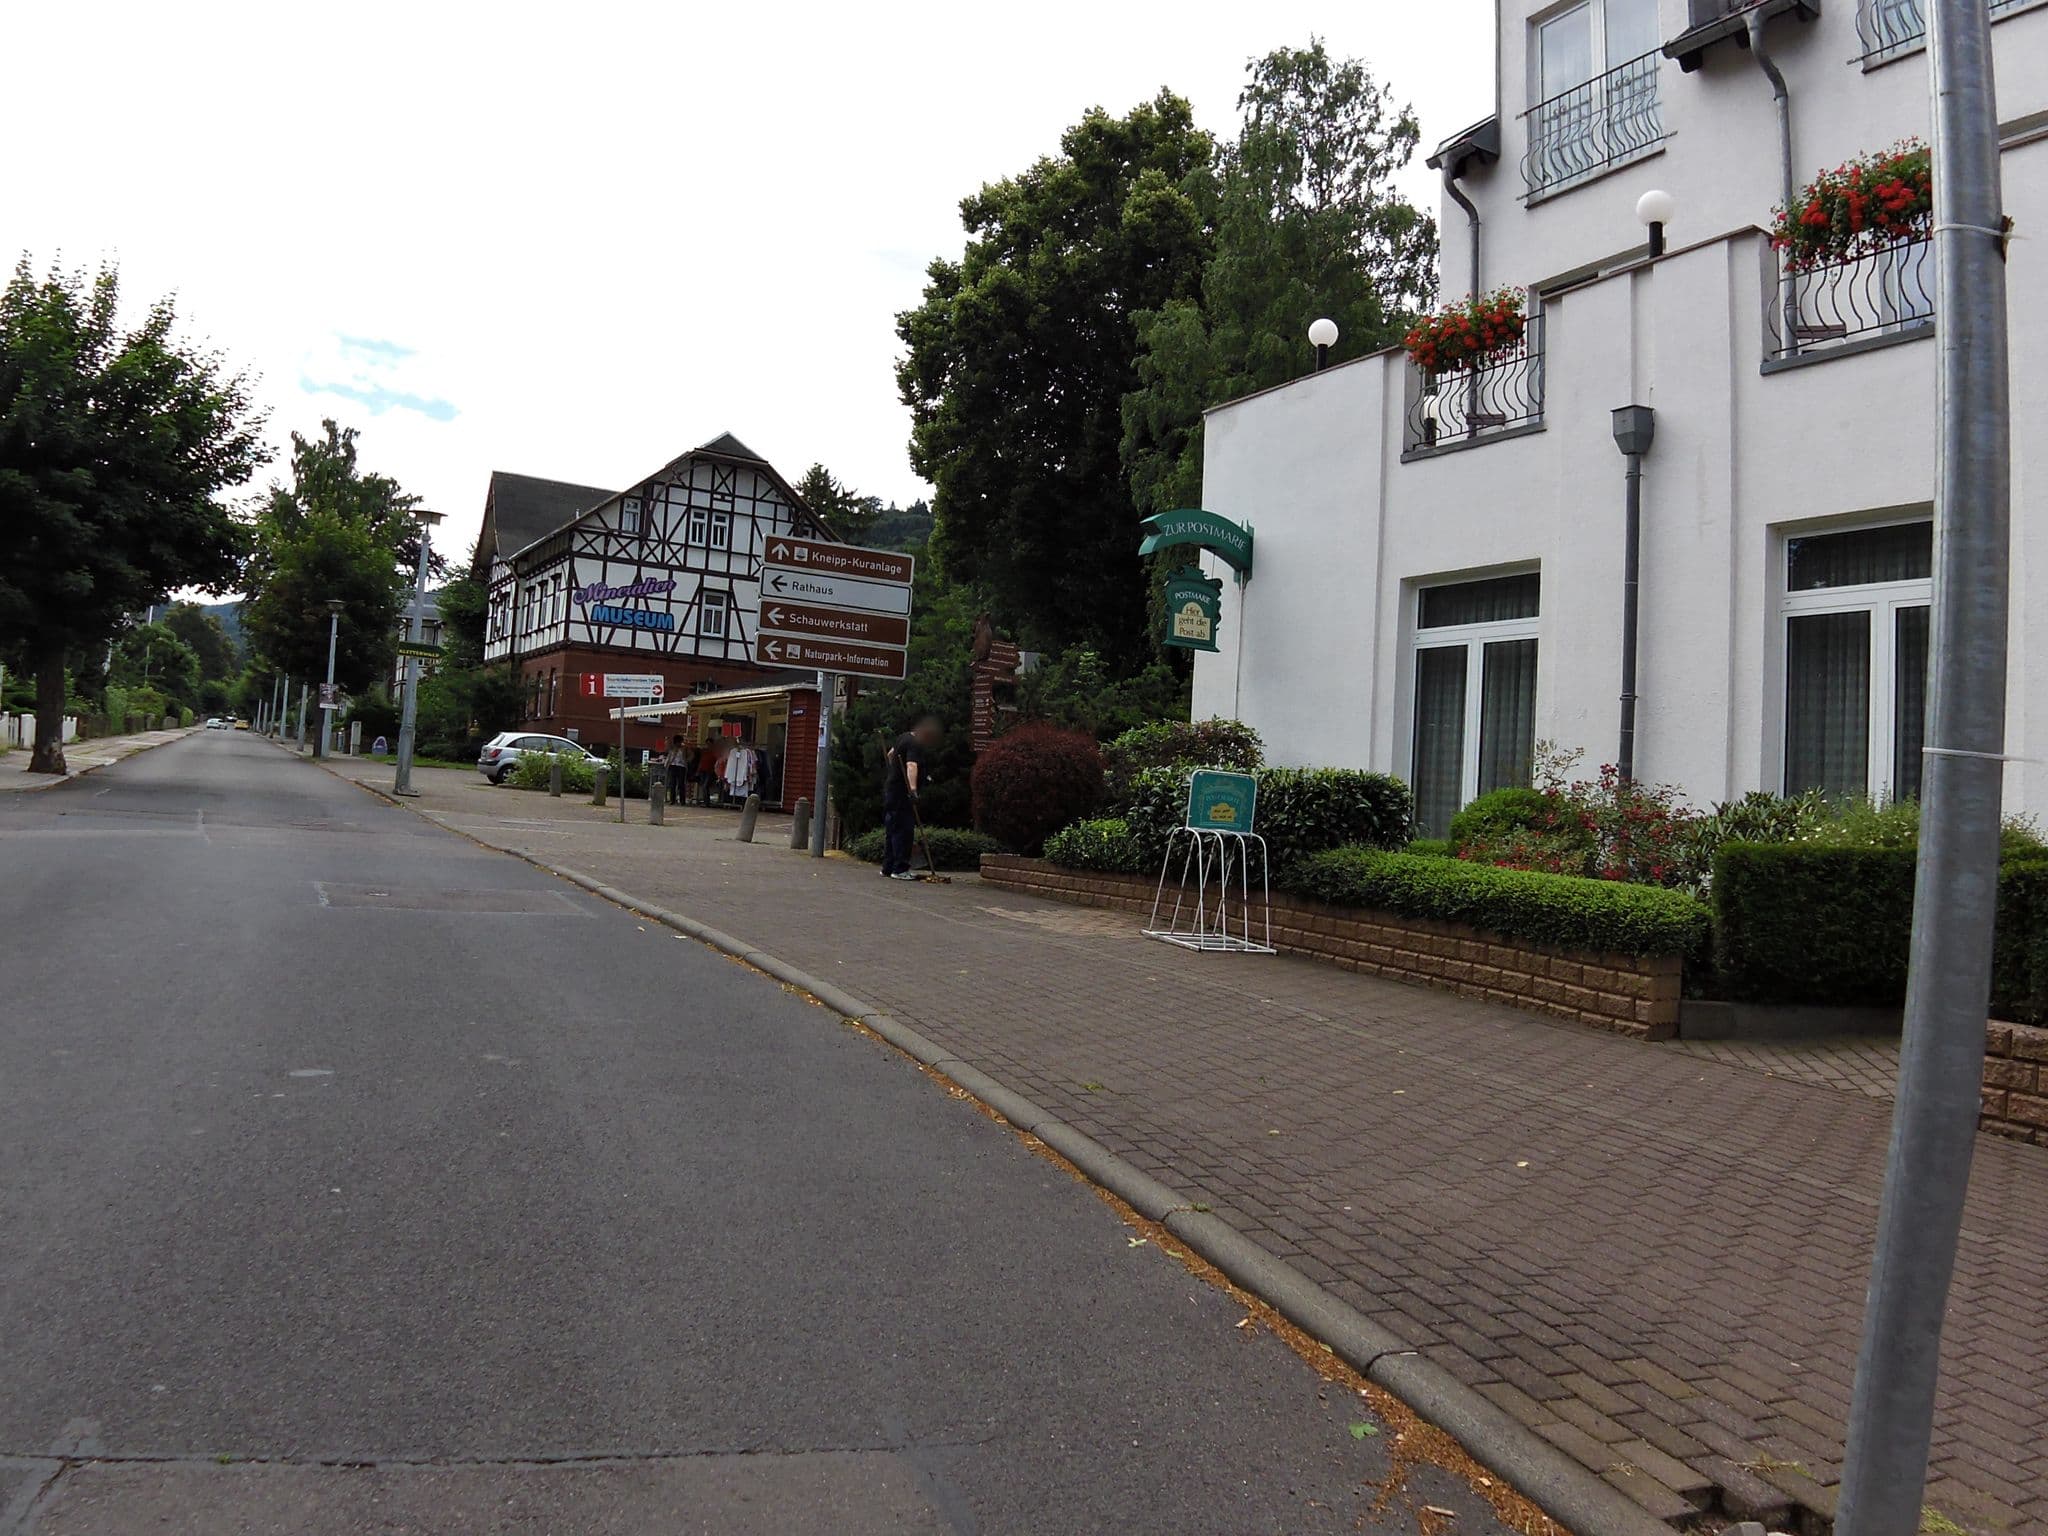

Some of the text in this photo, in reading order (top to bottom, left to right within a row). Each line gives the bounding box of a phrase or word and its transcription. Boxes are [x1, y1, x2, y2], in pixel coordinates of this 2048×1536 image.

[1163, 521, 1246, 551] ZUR POSTMARIE
[811, 551, 902, 575] Kneipp-Kuranlage
[573, 577, 677, 605] Mineralien
[791, 580, 834, 595] Rathaus
[789, 613, 869, 633] Schauwerkstatt
[804, 648, 889, 668] Naturpark-Information
